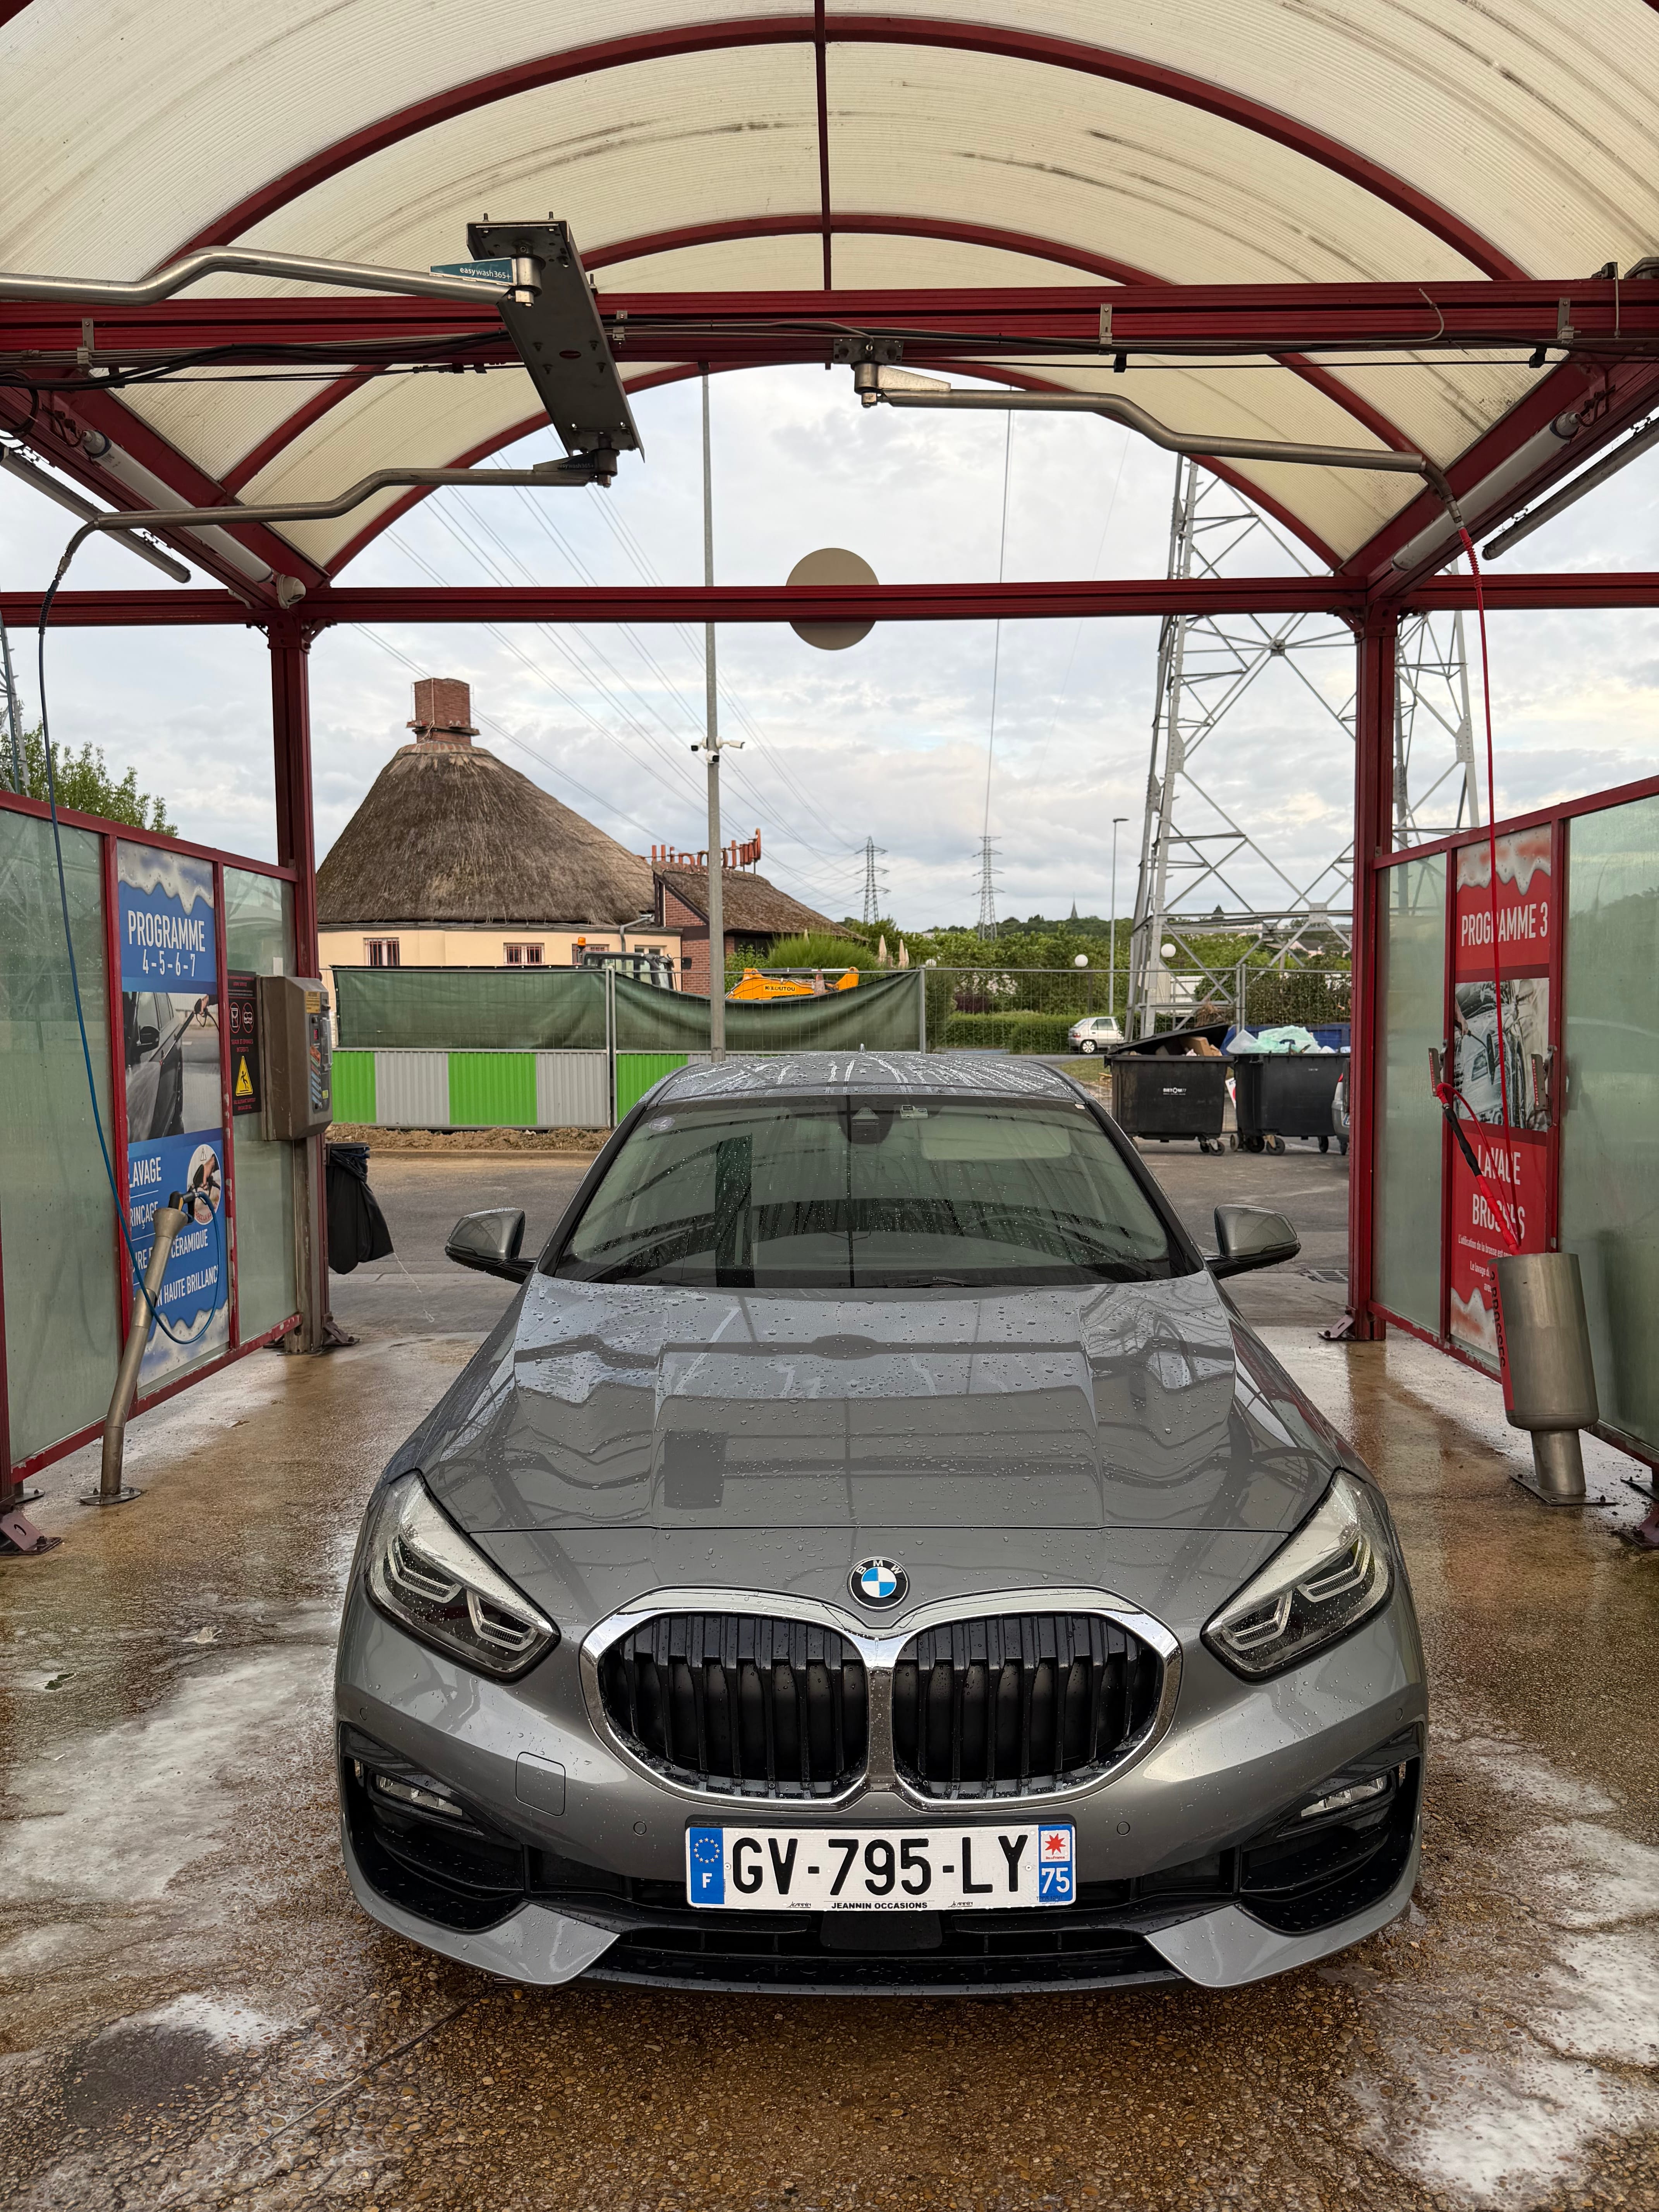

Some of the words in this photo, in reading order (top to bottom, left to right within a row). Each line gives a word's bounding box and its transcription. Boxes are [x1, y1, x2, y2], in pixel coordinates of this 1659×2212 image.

[460, 267, 511, 279] easywash365+
[128, 910, 205, 952] PROGRAMME
[1540, 902, 1548, 937] 3
[171, 1229, 208, 1258] CÉRAMIQUE
[164, 1278, 185, 1304] HAUTE
[187, 1265, 218, 1294] BRILLANC
[856, 1559, 902, 1575] BMW
[732, 1834, 1029, 1896] GV-795-LY
[702, 1873, 713, 1888] F
[1041, 1867, 1070, 1894] 75
